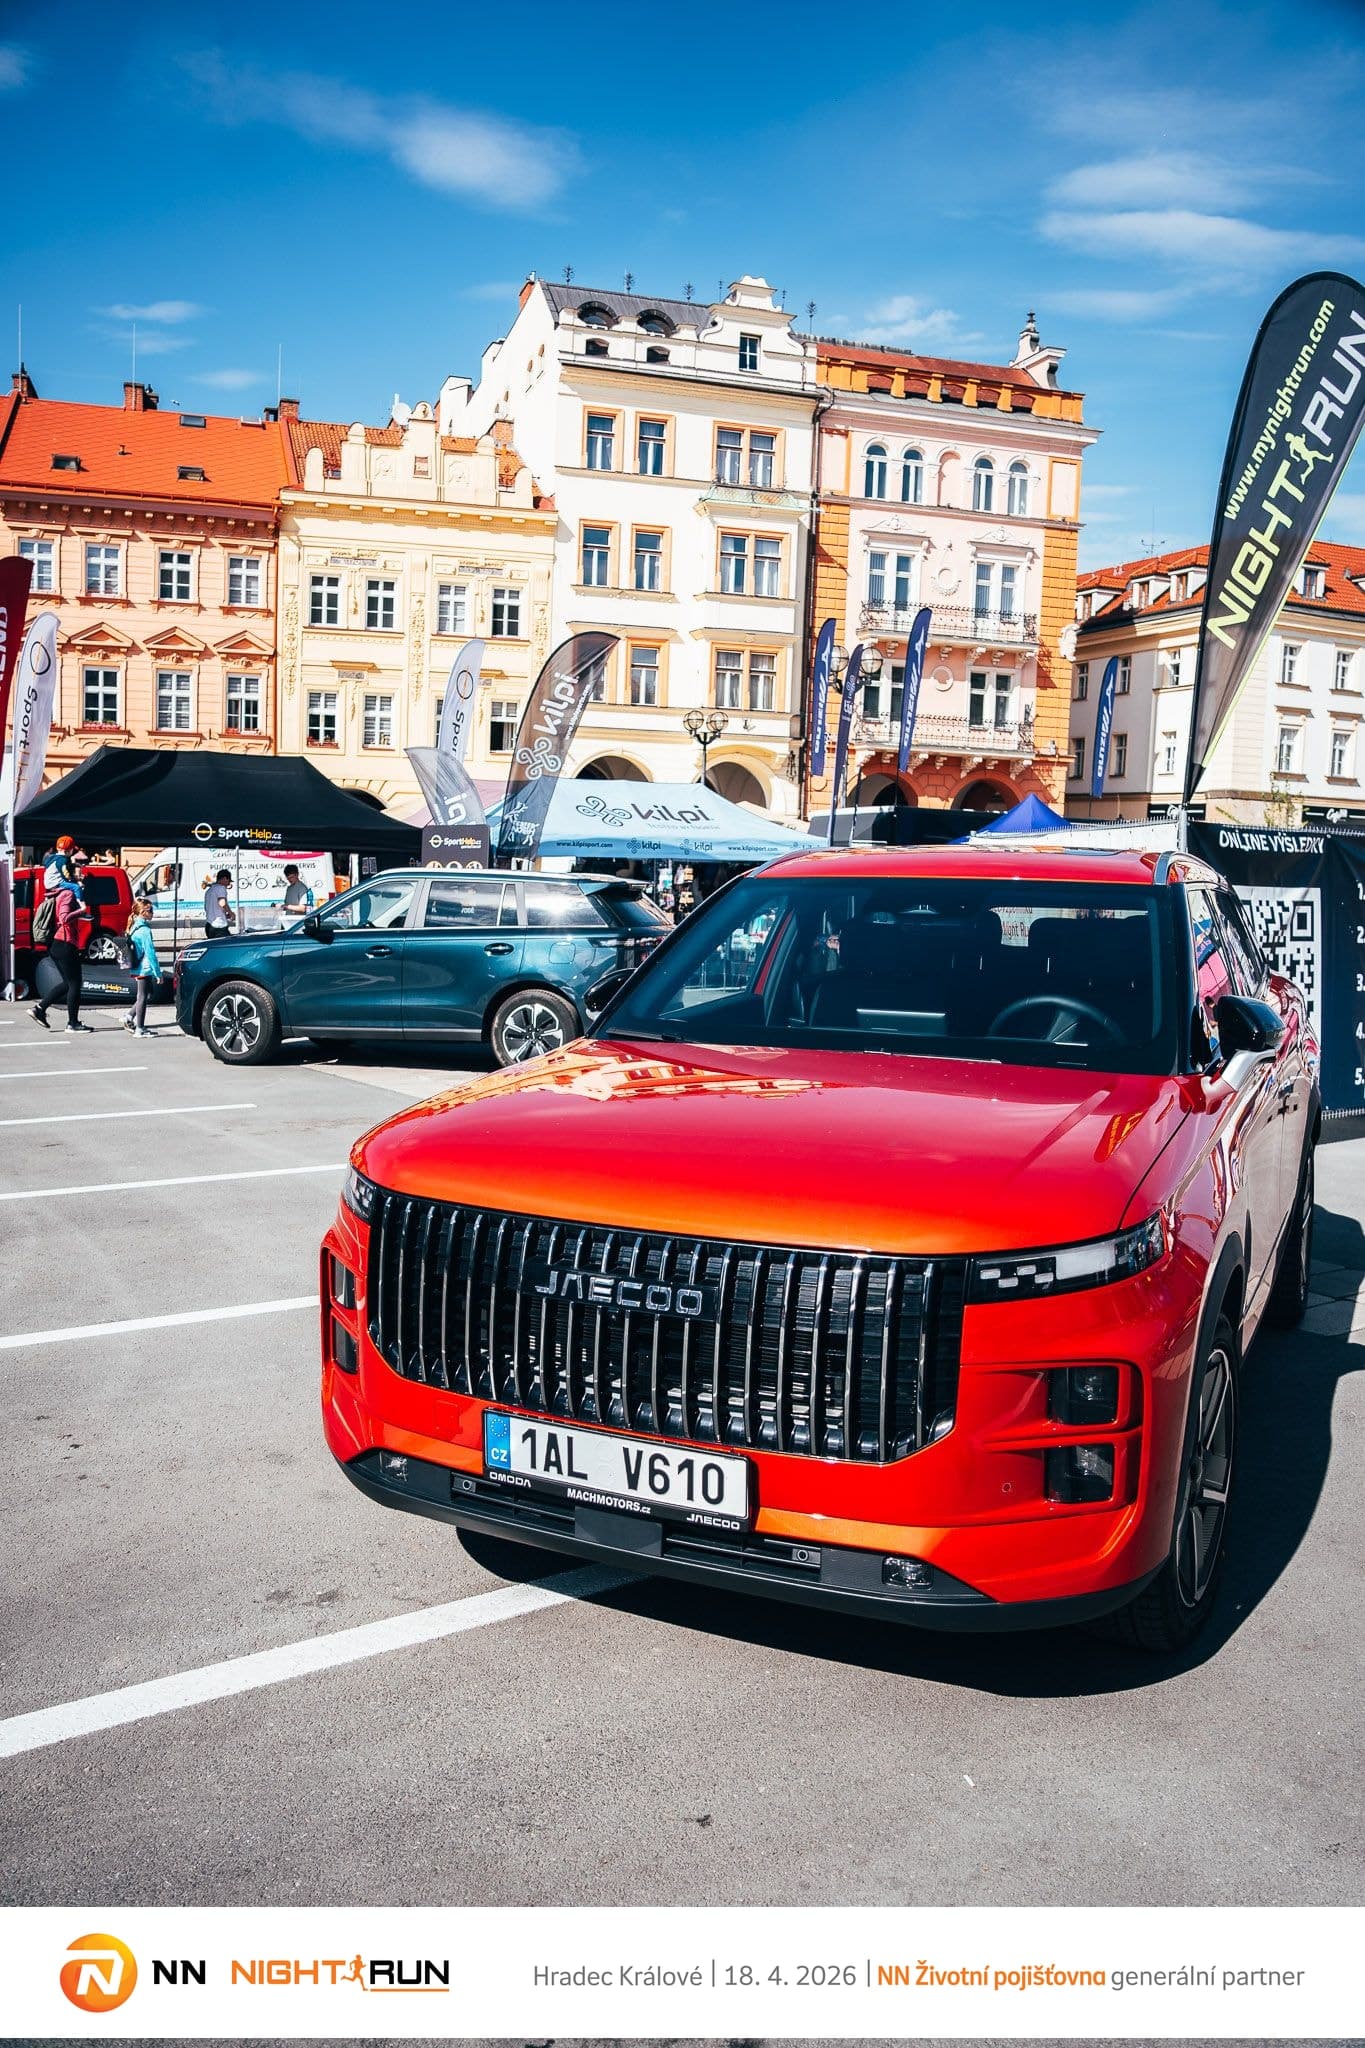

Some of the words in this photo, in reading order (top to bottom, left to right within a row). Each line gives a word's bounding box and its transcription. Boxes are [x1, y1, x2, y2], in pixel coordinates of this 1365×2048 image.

[1224, 299, 1335, 521] www.mynightrun.com
[1206, 459, 1305, 650] NIGHT
[533, 672, 580, 736] kilpi
[631, 803, 712, 824] kilpi
[218, 827, 282, 840] SportHelp.cz
[556, 840, 613, 848] www.kilpisport.com
[1219, 829, 1269, 851] ONLINE
[641, 841, 661, 851] kilpi
[694, 841, 713, 851] kilpi
[534, 1270, 703, 1316] JAECOO
[491, 1447, 508, 1463] CZ
[521, 1428, 588, 1481] 1AL
[622, 1446, 725, 1506] V610
[489, 1471, 532, 1489] OMODA
[567, 1488, 651, 1514] MACHMOTORS.cz
[686, 1513, 741, 1532] JAECOO
